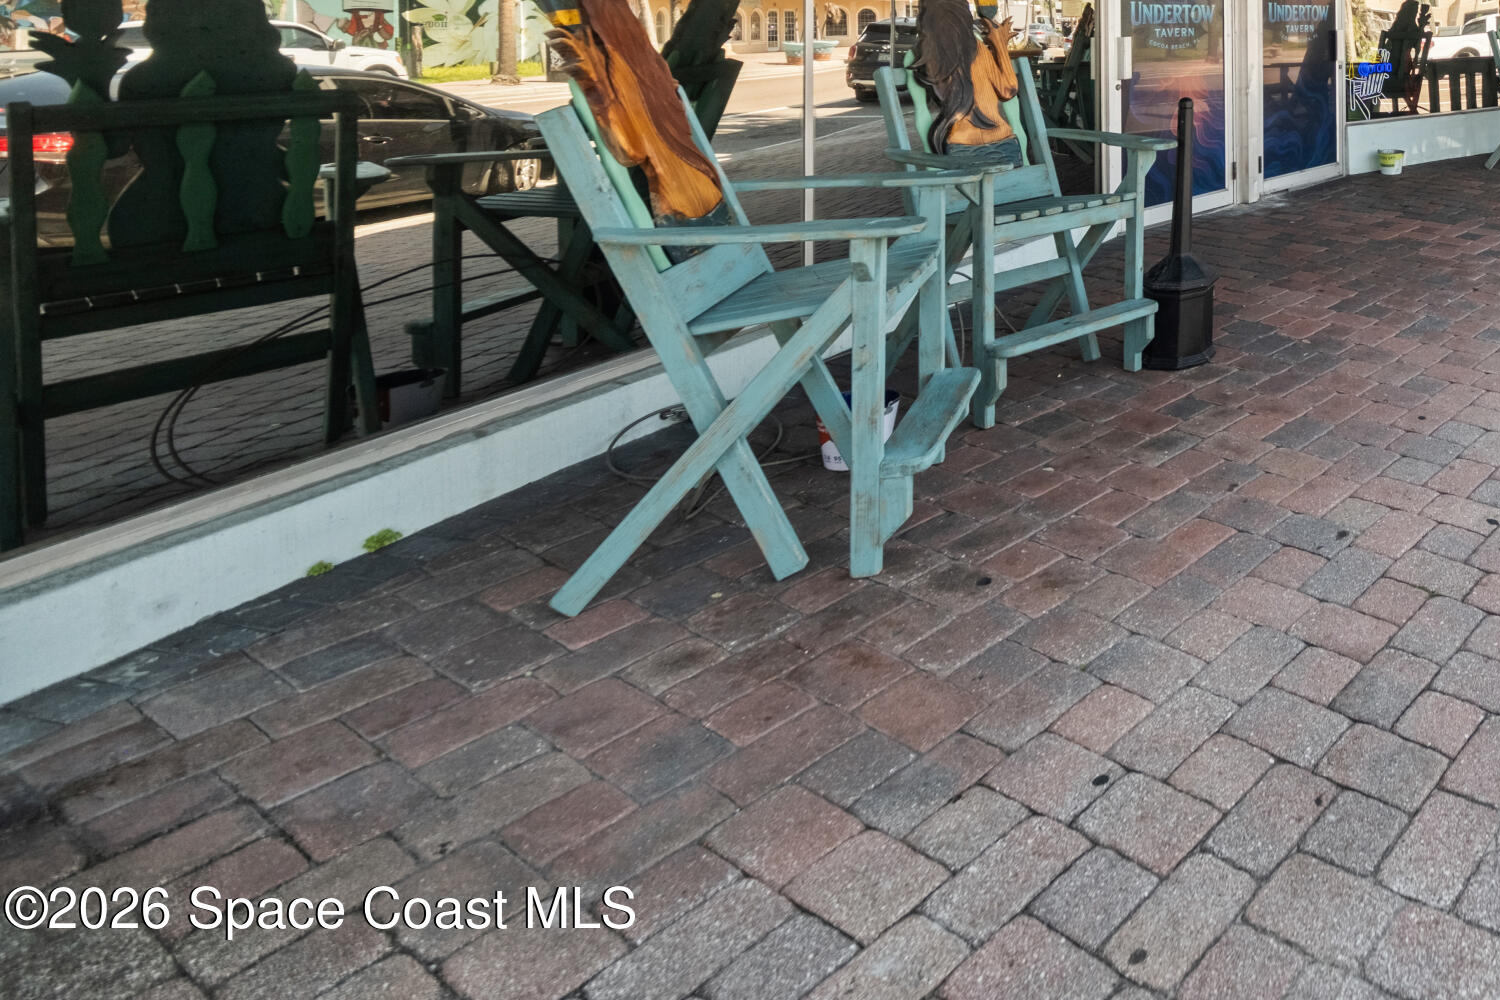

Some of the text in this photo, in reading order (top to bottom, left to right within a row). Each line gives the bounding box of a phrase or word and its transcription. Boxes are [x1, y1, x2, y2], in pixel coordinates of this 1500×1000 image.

[1130, 0, 1215, 26] UNDERTOW
[1268, 1, 1330, 23] UNDERTOW
[1154, 27, 1195, 38] TAVERN
[1285, 24, 1315, 33] TAVERN
